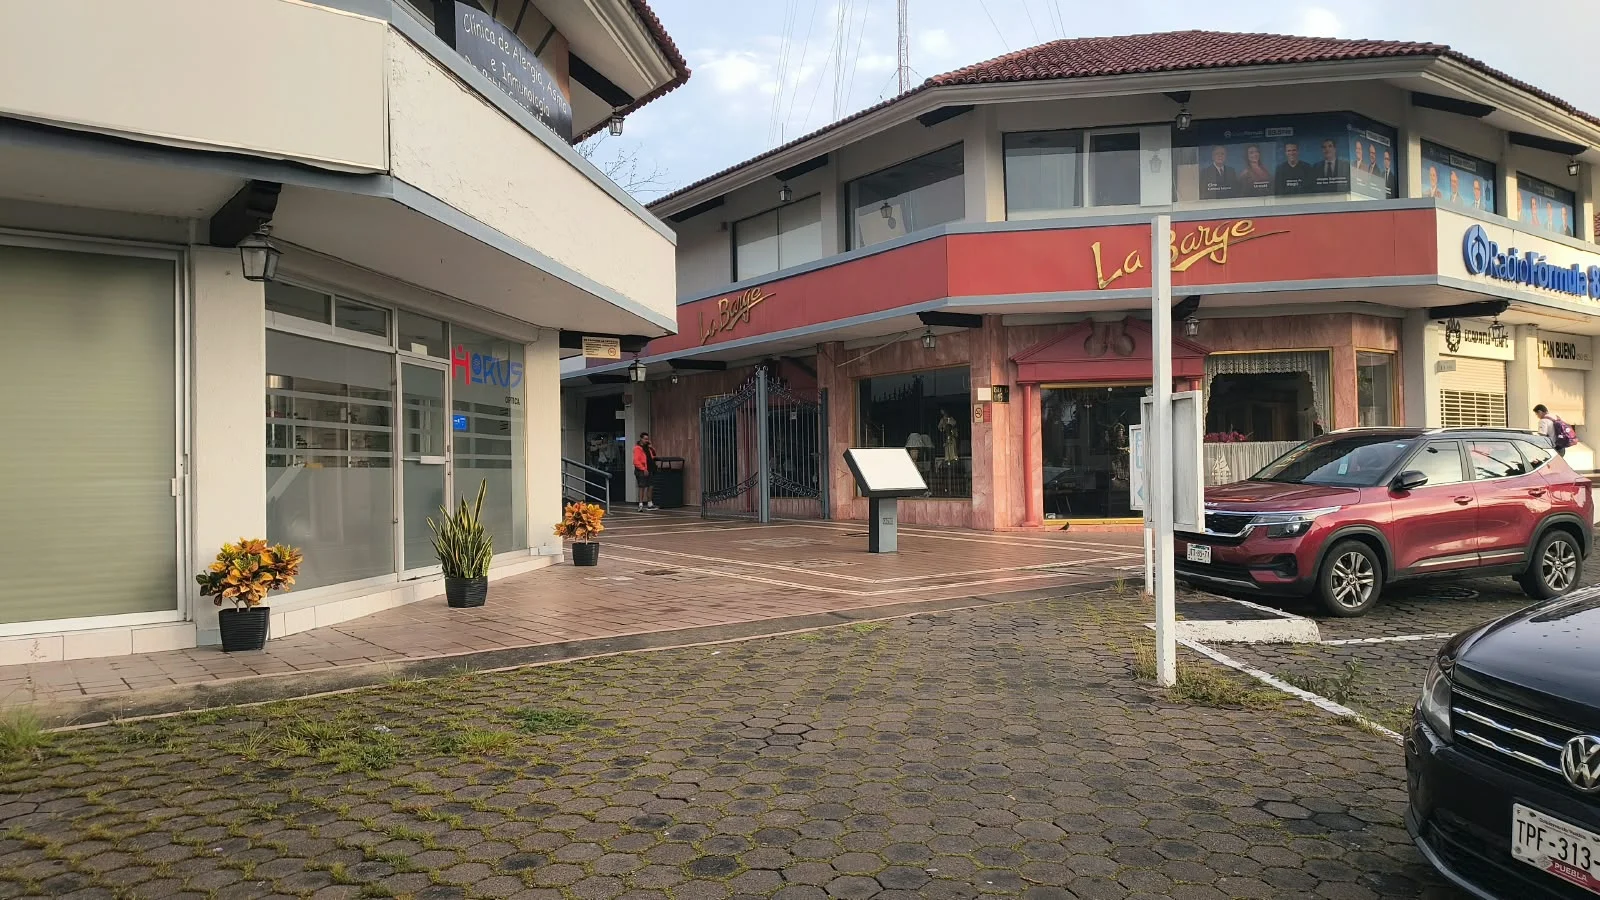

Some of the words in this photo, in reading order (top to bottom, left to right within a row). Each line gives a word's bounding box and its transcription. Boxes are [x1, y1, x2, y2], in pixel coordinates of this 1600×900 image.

[463, 13, 496, 45] Clínica
[498, 32, 510, 55] de
[547, 82, 567, 115] Asma
[490, 58, 497, 72] e
[1091, 241, 1144, 290] La
[697, 311, 718, 346] La
[718, 286, 763, 332] Barge
[1542, 340, 1555, 358] PAN
[1555, 341, 1576, 361] BUENO
[1554, 862, 1588, 882] PUEBLA
